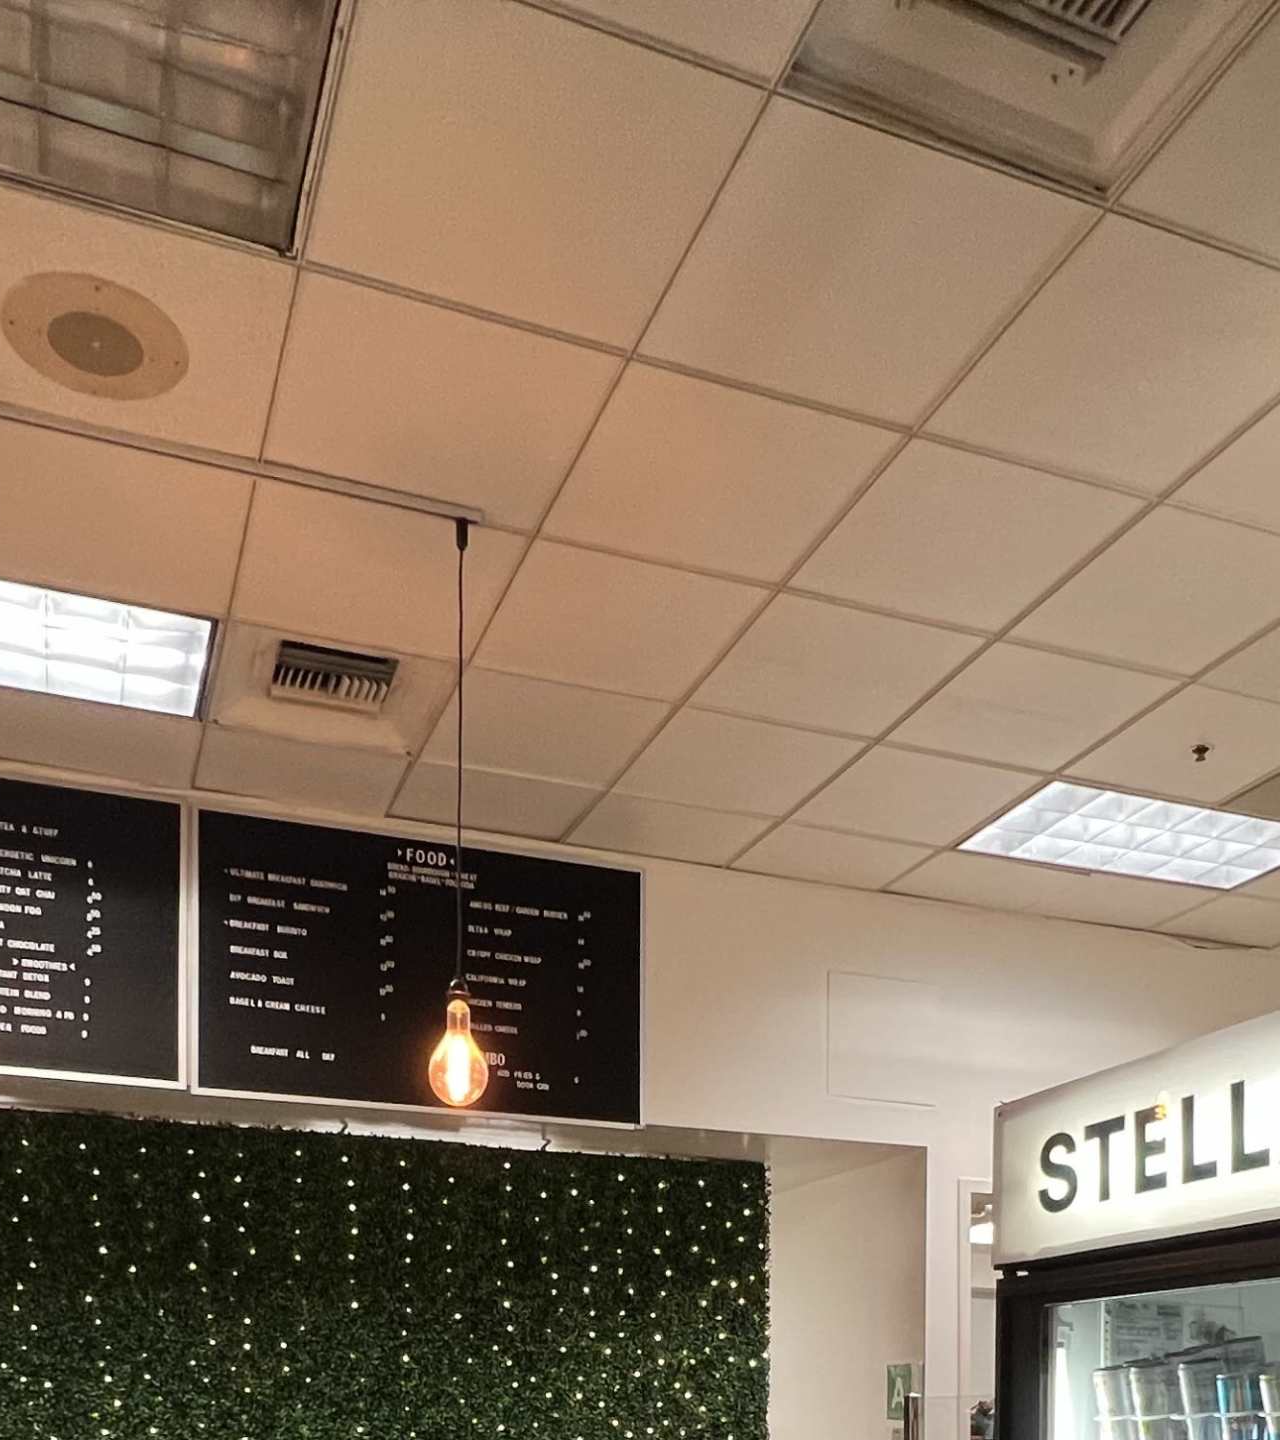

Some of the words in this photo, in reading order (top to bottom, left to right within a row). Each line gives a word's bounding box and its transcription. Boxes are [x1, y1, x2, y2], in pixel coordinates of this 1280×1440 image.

[406, 848, 447, 866] FOOD
[28, 871, 53, 881] LATTE
[7, 939, 55, 952] CHOCOLATE
[229, 971, 267, 982] AVOCADO
[229, 996, 255, 1007] BAGEL
[891, 1377, 904, 1408] A
